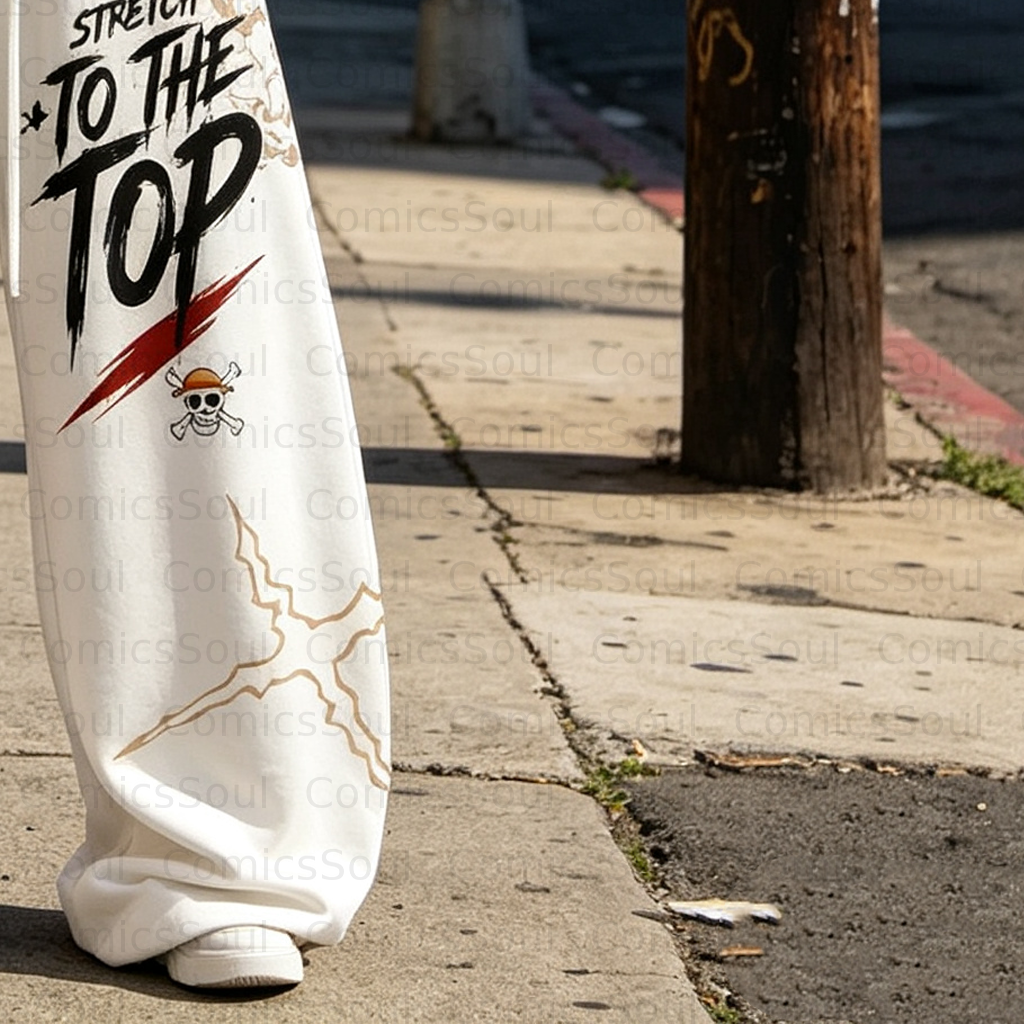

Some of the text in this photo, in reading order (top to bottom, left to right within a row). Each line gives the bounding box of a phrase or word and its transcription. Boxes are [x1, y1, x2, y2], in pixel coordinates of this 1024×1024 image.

[41, 15, 253, 166] TO THE
[31, 112, 263, 372] TOP
